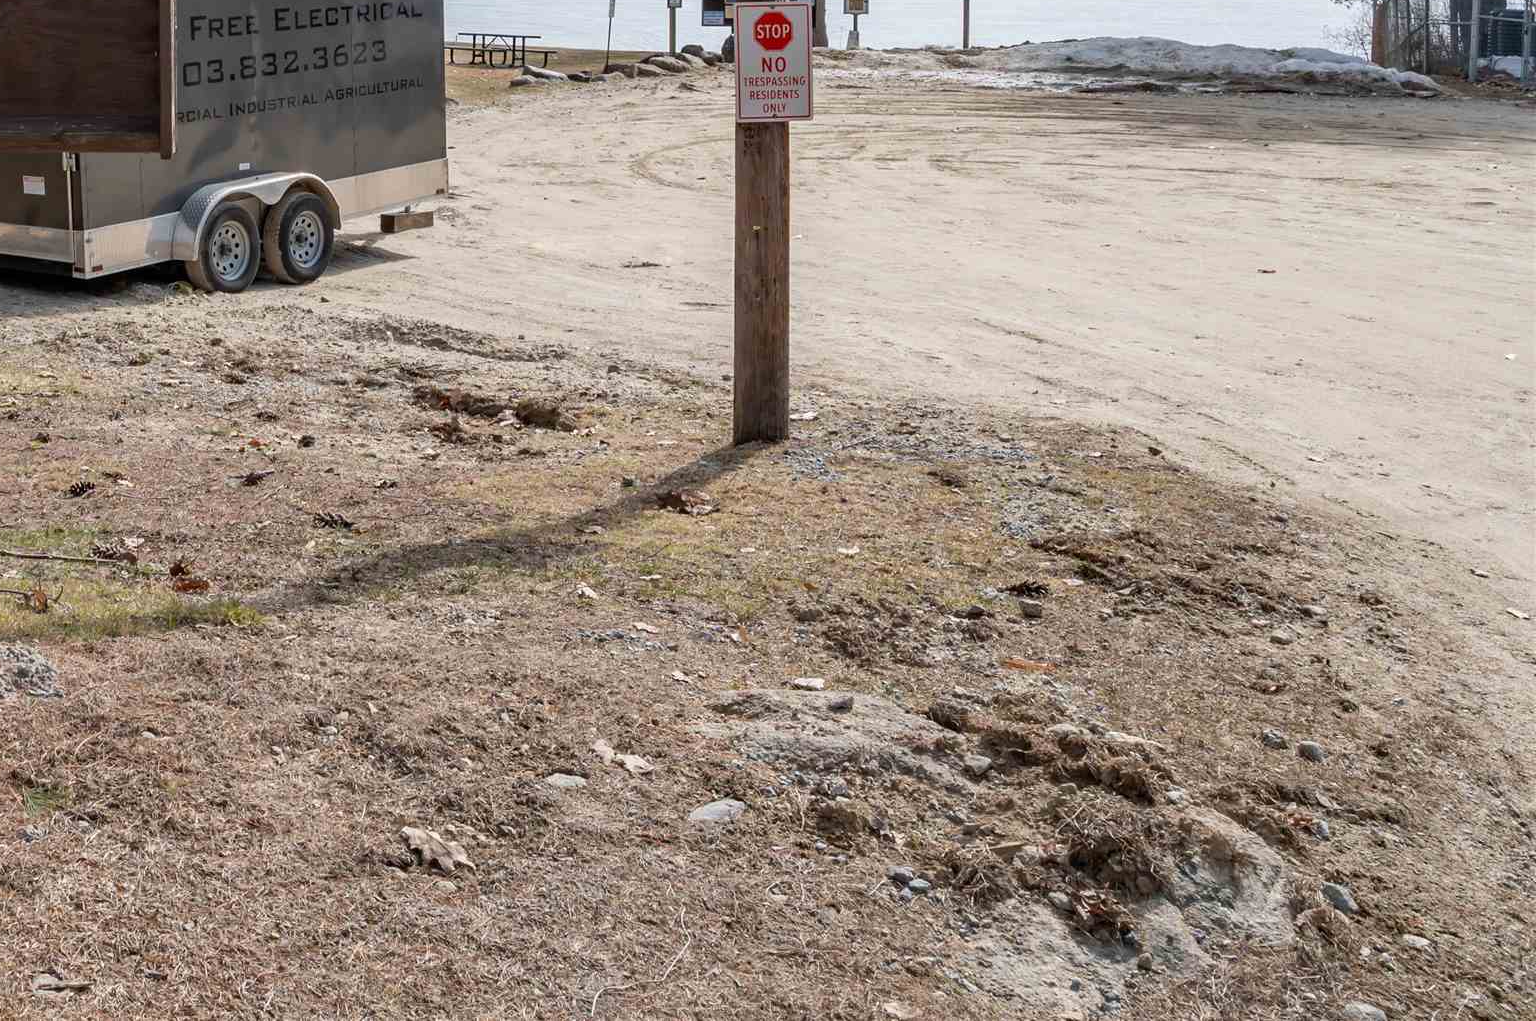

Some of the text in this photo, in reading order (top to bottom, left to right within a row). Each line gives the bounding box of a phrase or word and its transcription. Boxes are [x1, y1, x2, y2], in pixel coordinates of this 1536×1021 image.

[190, 2, 423, 41] FREE ELECTRICAL
[757, 23, 791, 39] STOP
[761, 56, 787, 73] NO
[744, 77, 806, 87] TRESPASSING
[229, 95, 319, 117] INDUSTRIAL
[324, 77, 424, 101] AGRICULTURAL
[750, 89, 800, 100] RESIDENTS
[763, 102, 786, 114] ONLY
